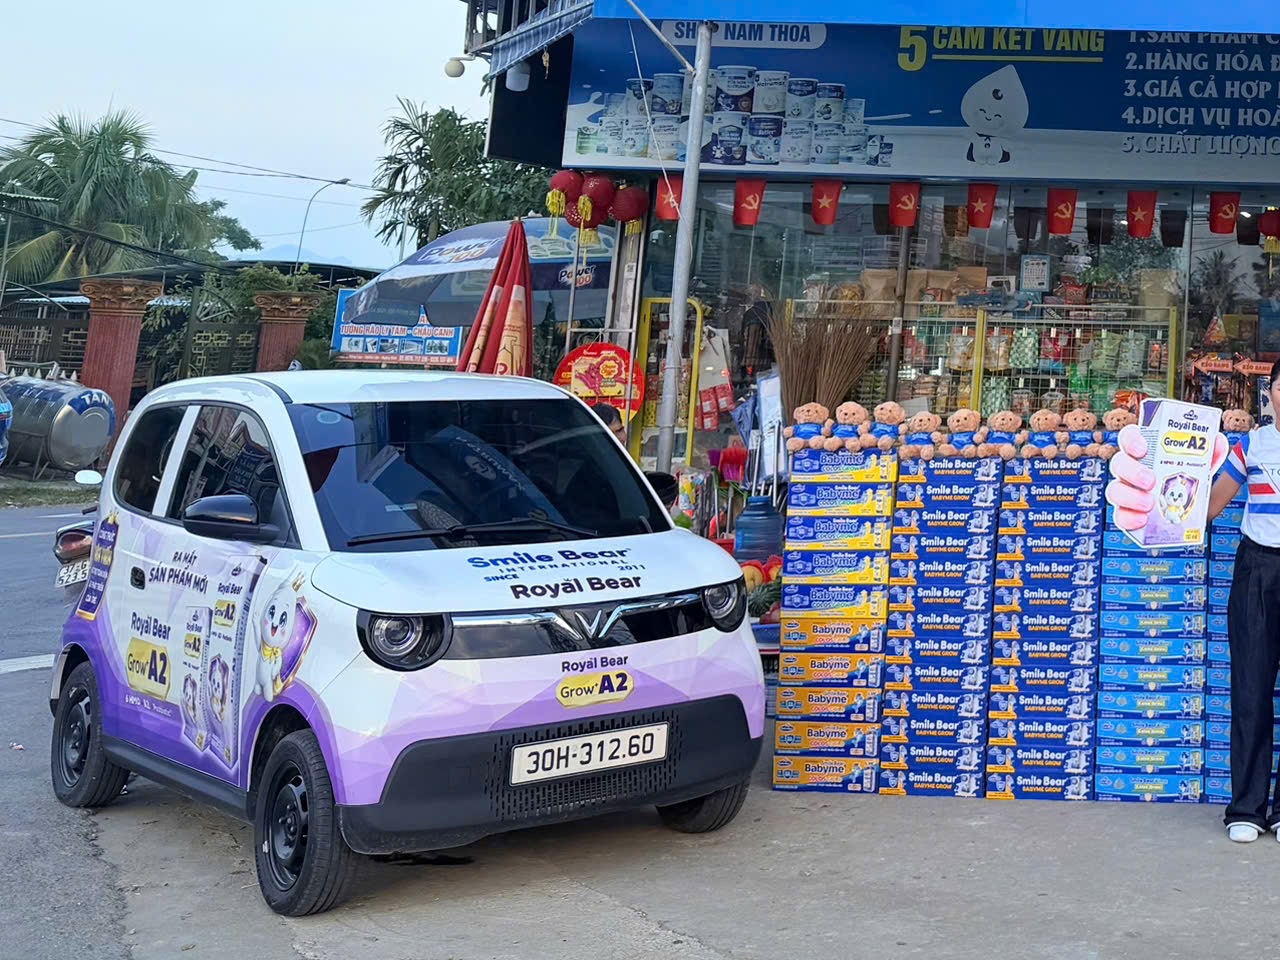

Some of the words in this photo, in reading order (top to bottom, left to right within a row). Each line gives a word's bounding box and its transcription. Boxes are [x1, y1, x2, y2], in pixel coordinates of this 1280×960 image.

[674, 21, 717, 38] SHP
[724, 24, 763, 41] NAM
[767, 25, 811, 43] THOA
[898, 26, 927, 71] 5
[1126, 51, 1208, 70] 2.HÀNG
[1216, 50, 1264, 72] HÓA
[1123, 77, 1182, 98] 3.GIÁ
[1189, 75, 1217, 98] CẢ
[1224, 81, 1272, 103] HỢP
[1122, 107, 1194, 128] 4.DỊCH
[1202, 108, 1230, 129] VỤ
[1168, 420, 1190, 430] Royal
[1192, 422, 1209, 432] Bear
[1187, 436, 1206, 450] A2
[929, 460, 953, 469] Smile
[955, 460, 977, 469] Bear
[1034, 460, 1058, 469] Smile
[1059, 460, 1081, 469] Bear
[926, 485, 951, 495] Smile
[952, 485, 974, 495] Bear
[922, 511, 946, 521] Smile
[948, 511, 969, 521] Bear
[173, 552, 182, 561] RA
[468, 552, 553, 568] Smile
[558, 548, 628, 560] Bear
[499, 559, 628, 573] INTERNATIONAL
[484, 574, 519, 582] SINCE
[511, 578, 583, 599] Royal
[586, 576, 641, 590] Bear
[131, 612, 150, 636] Royal
[152, 618, 171, 640] Bear
[1022, 614, 1047, 625] Smile
[1048, 614, 1070, 625] Bear
[812, 624, 851, 635] Babyme
[148, 650, 167, 685] A2
[562, 658, 597, 672] Royal
[600, 655, 628, 667] Bear
[599, 673, 628, 694] A2
[808, 694, 847, 704] Babyme
[527, 733, 654, 774] 30H-312.60
[805, 763, 844, 774] Babyme
[908, 773, 932, 783] Smile
[934, 773, 956, 783] Bear
[1016, 774, 1040, 784] Smile
[1042, 774, 1065, 784] Bear
